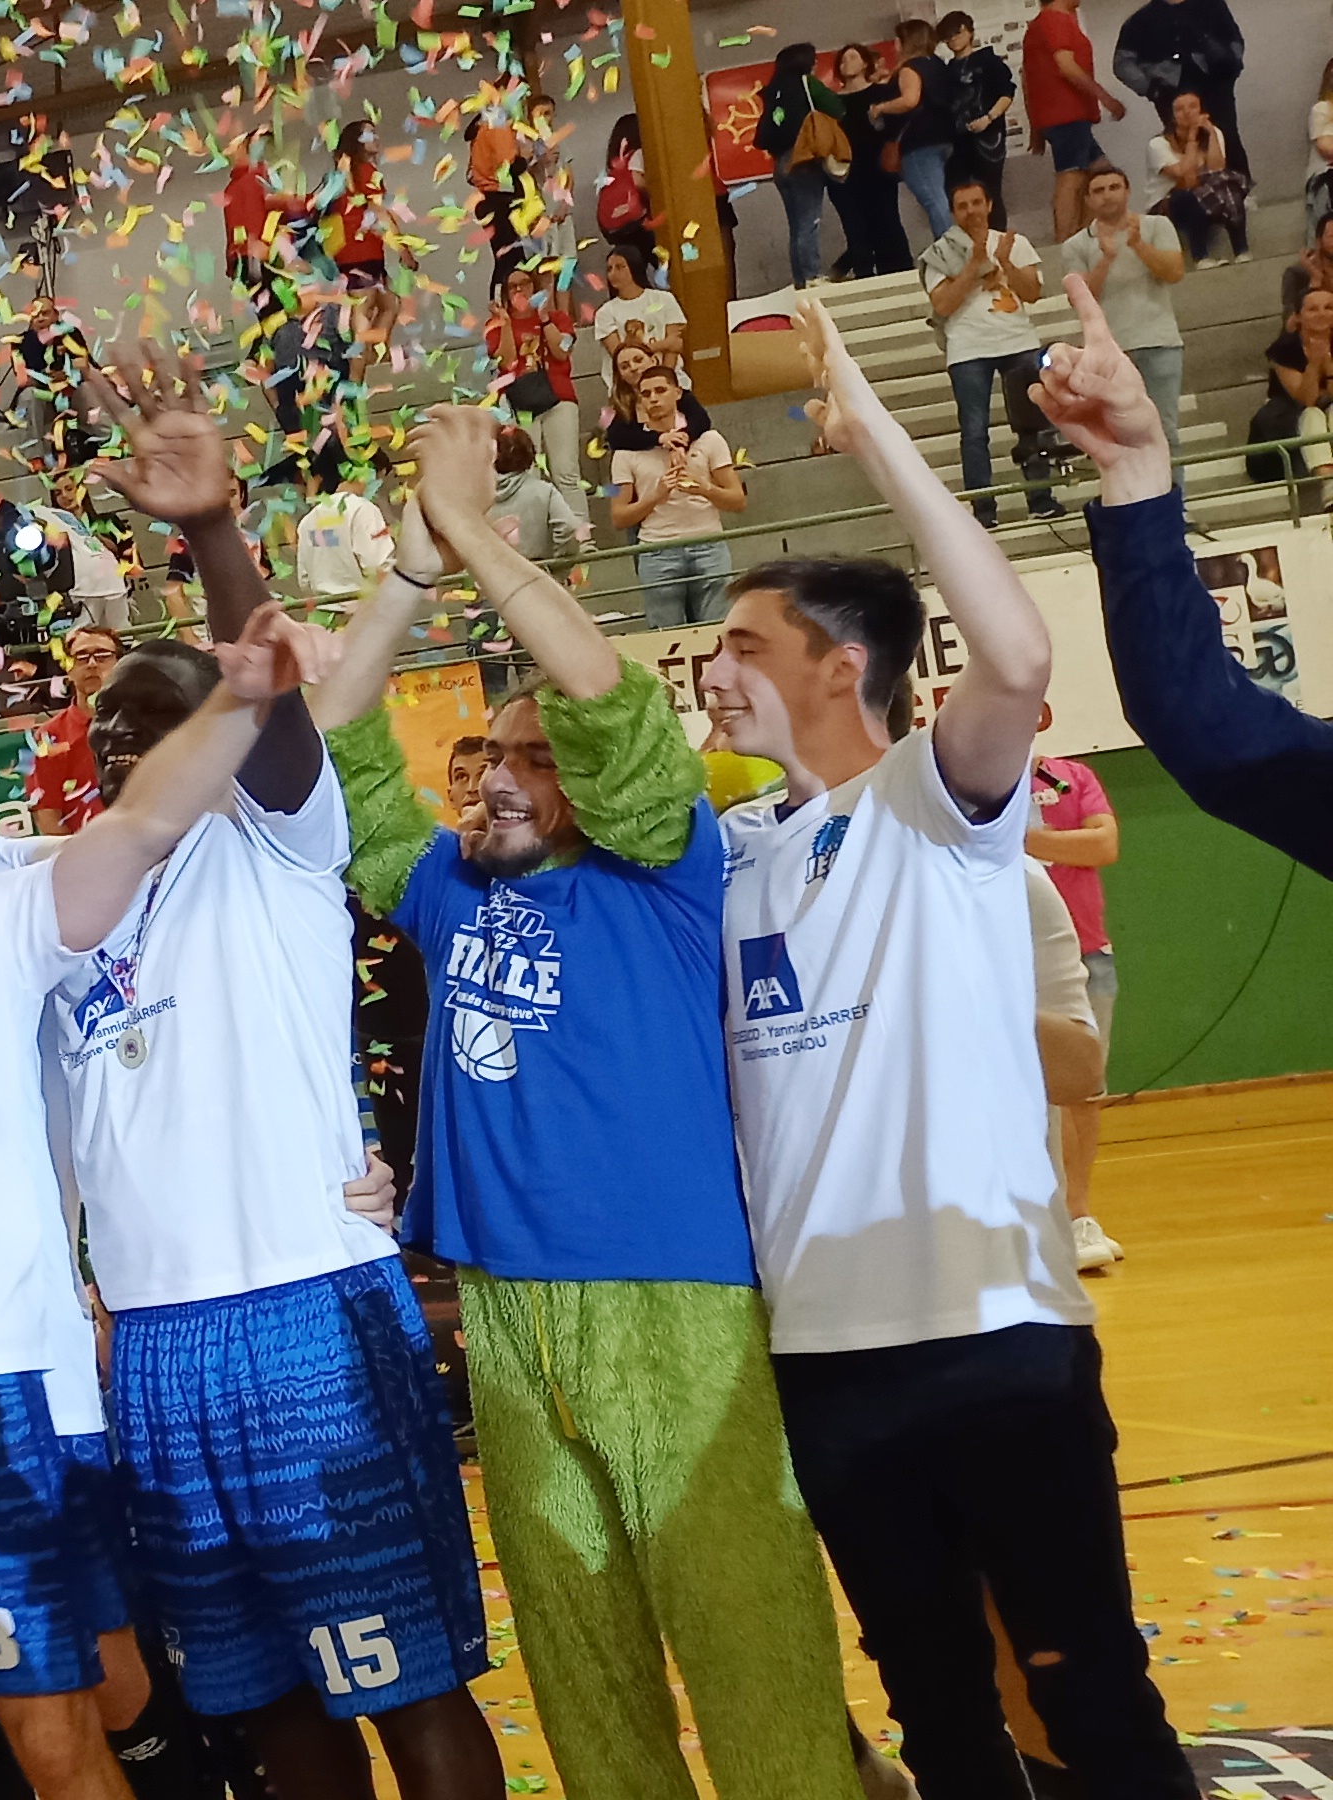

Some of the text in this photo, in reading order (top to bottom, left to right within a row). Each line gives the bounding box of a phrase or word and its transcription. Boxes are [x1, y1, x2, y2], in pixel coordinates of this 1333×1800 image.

[744, 976, 791, 1013] AXA
[809, 1003, 871, 1031] BARRER
[307, 1613, 403, 1697] 15
